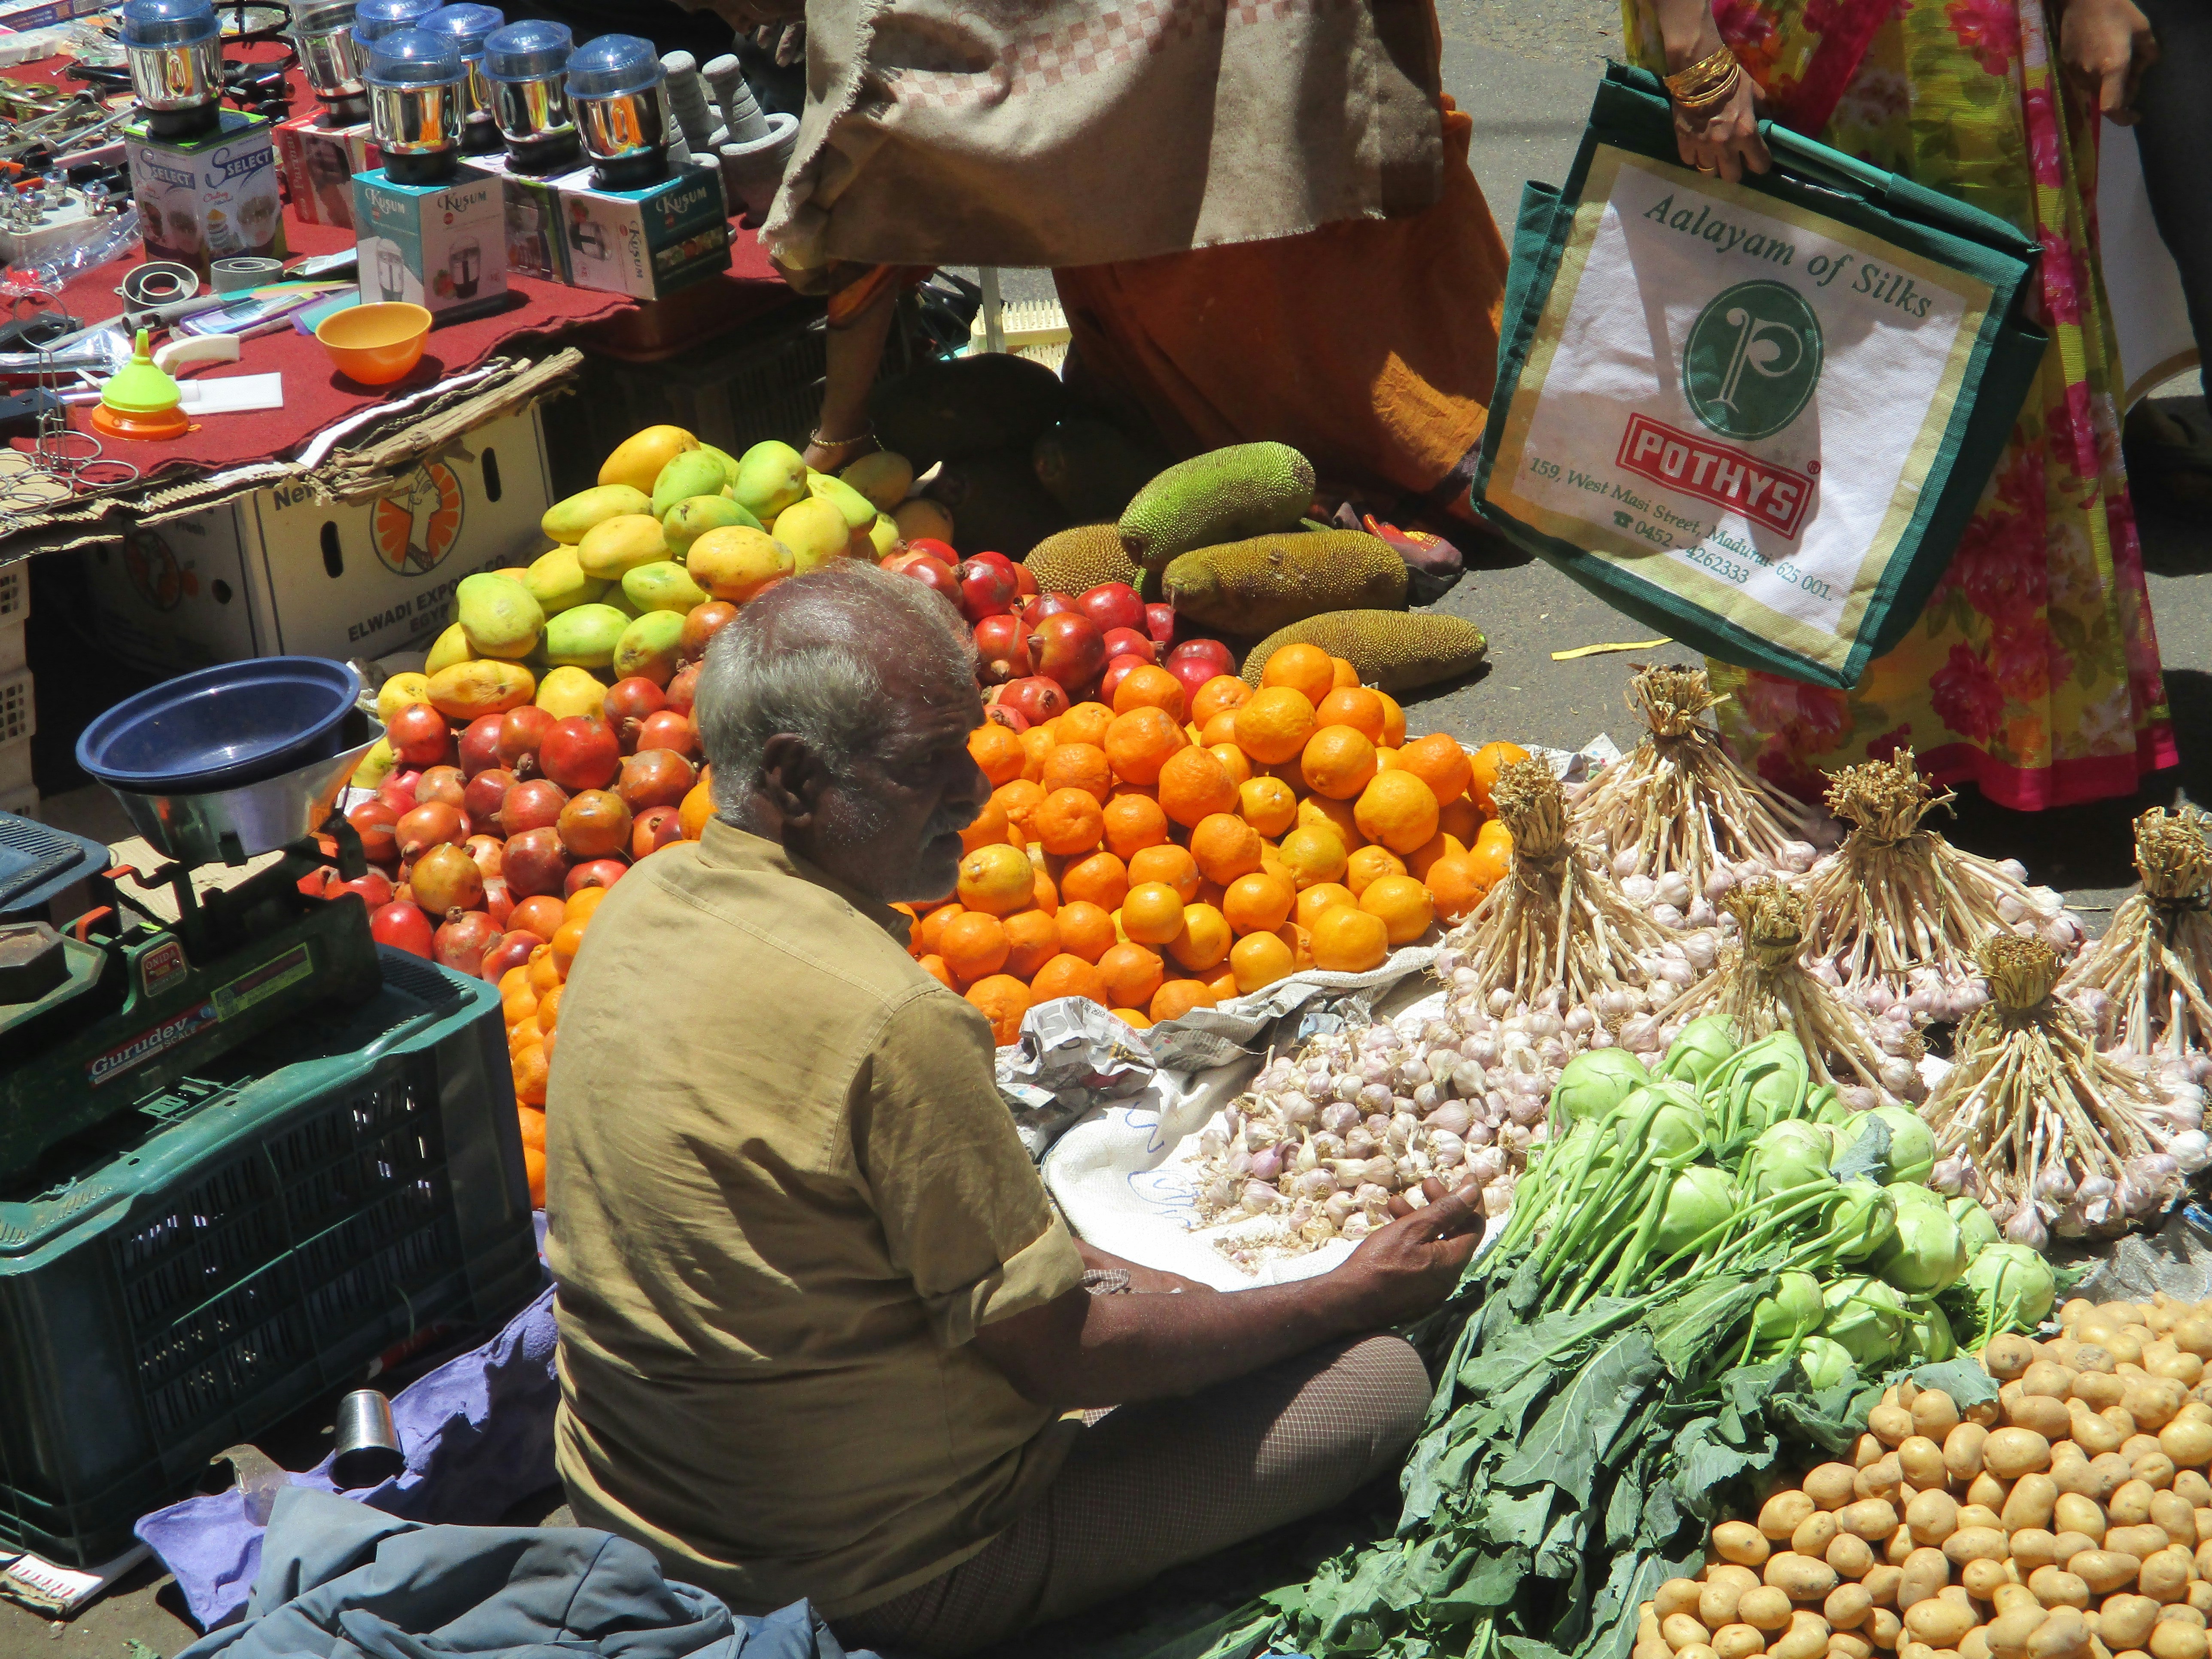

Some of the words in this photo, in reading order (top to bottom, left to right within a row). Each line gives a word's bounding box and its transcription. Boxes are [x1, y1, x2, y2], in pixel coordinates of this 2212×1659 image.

[226, 151, 269, 176] SELECT
[365, 188, 404, 215] KUSUM
[438, 191, 487, 213] KUSUM
[656, 187, 708, 213] KUSUM
[629, 220, 644, 278] KUSUM
[1643, 194, 1796, 265] Aalayam
[1807, 253, 1854, 287] of
[1852, 263, 1932, 318] Silks
[1633, 429, 1798, 521] POTHYS
[1530, 457, 1561, 483] 159,
[1568, 470, 1609, 494] West
[1610, 485, 1651, 512] Masi
[1653, 504, 1702, 537] Street,
[1776, 562, 1801, 583] 625
[1635, 521, 1673, 547] 0452
[1686, 545, 1750, 583] 4262333
[348, 601, 411, 642] ELWADI
[416, 566, 480, 611] EXPO
[92, 1018, 188, 1076] Gurudev
